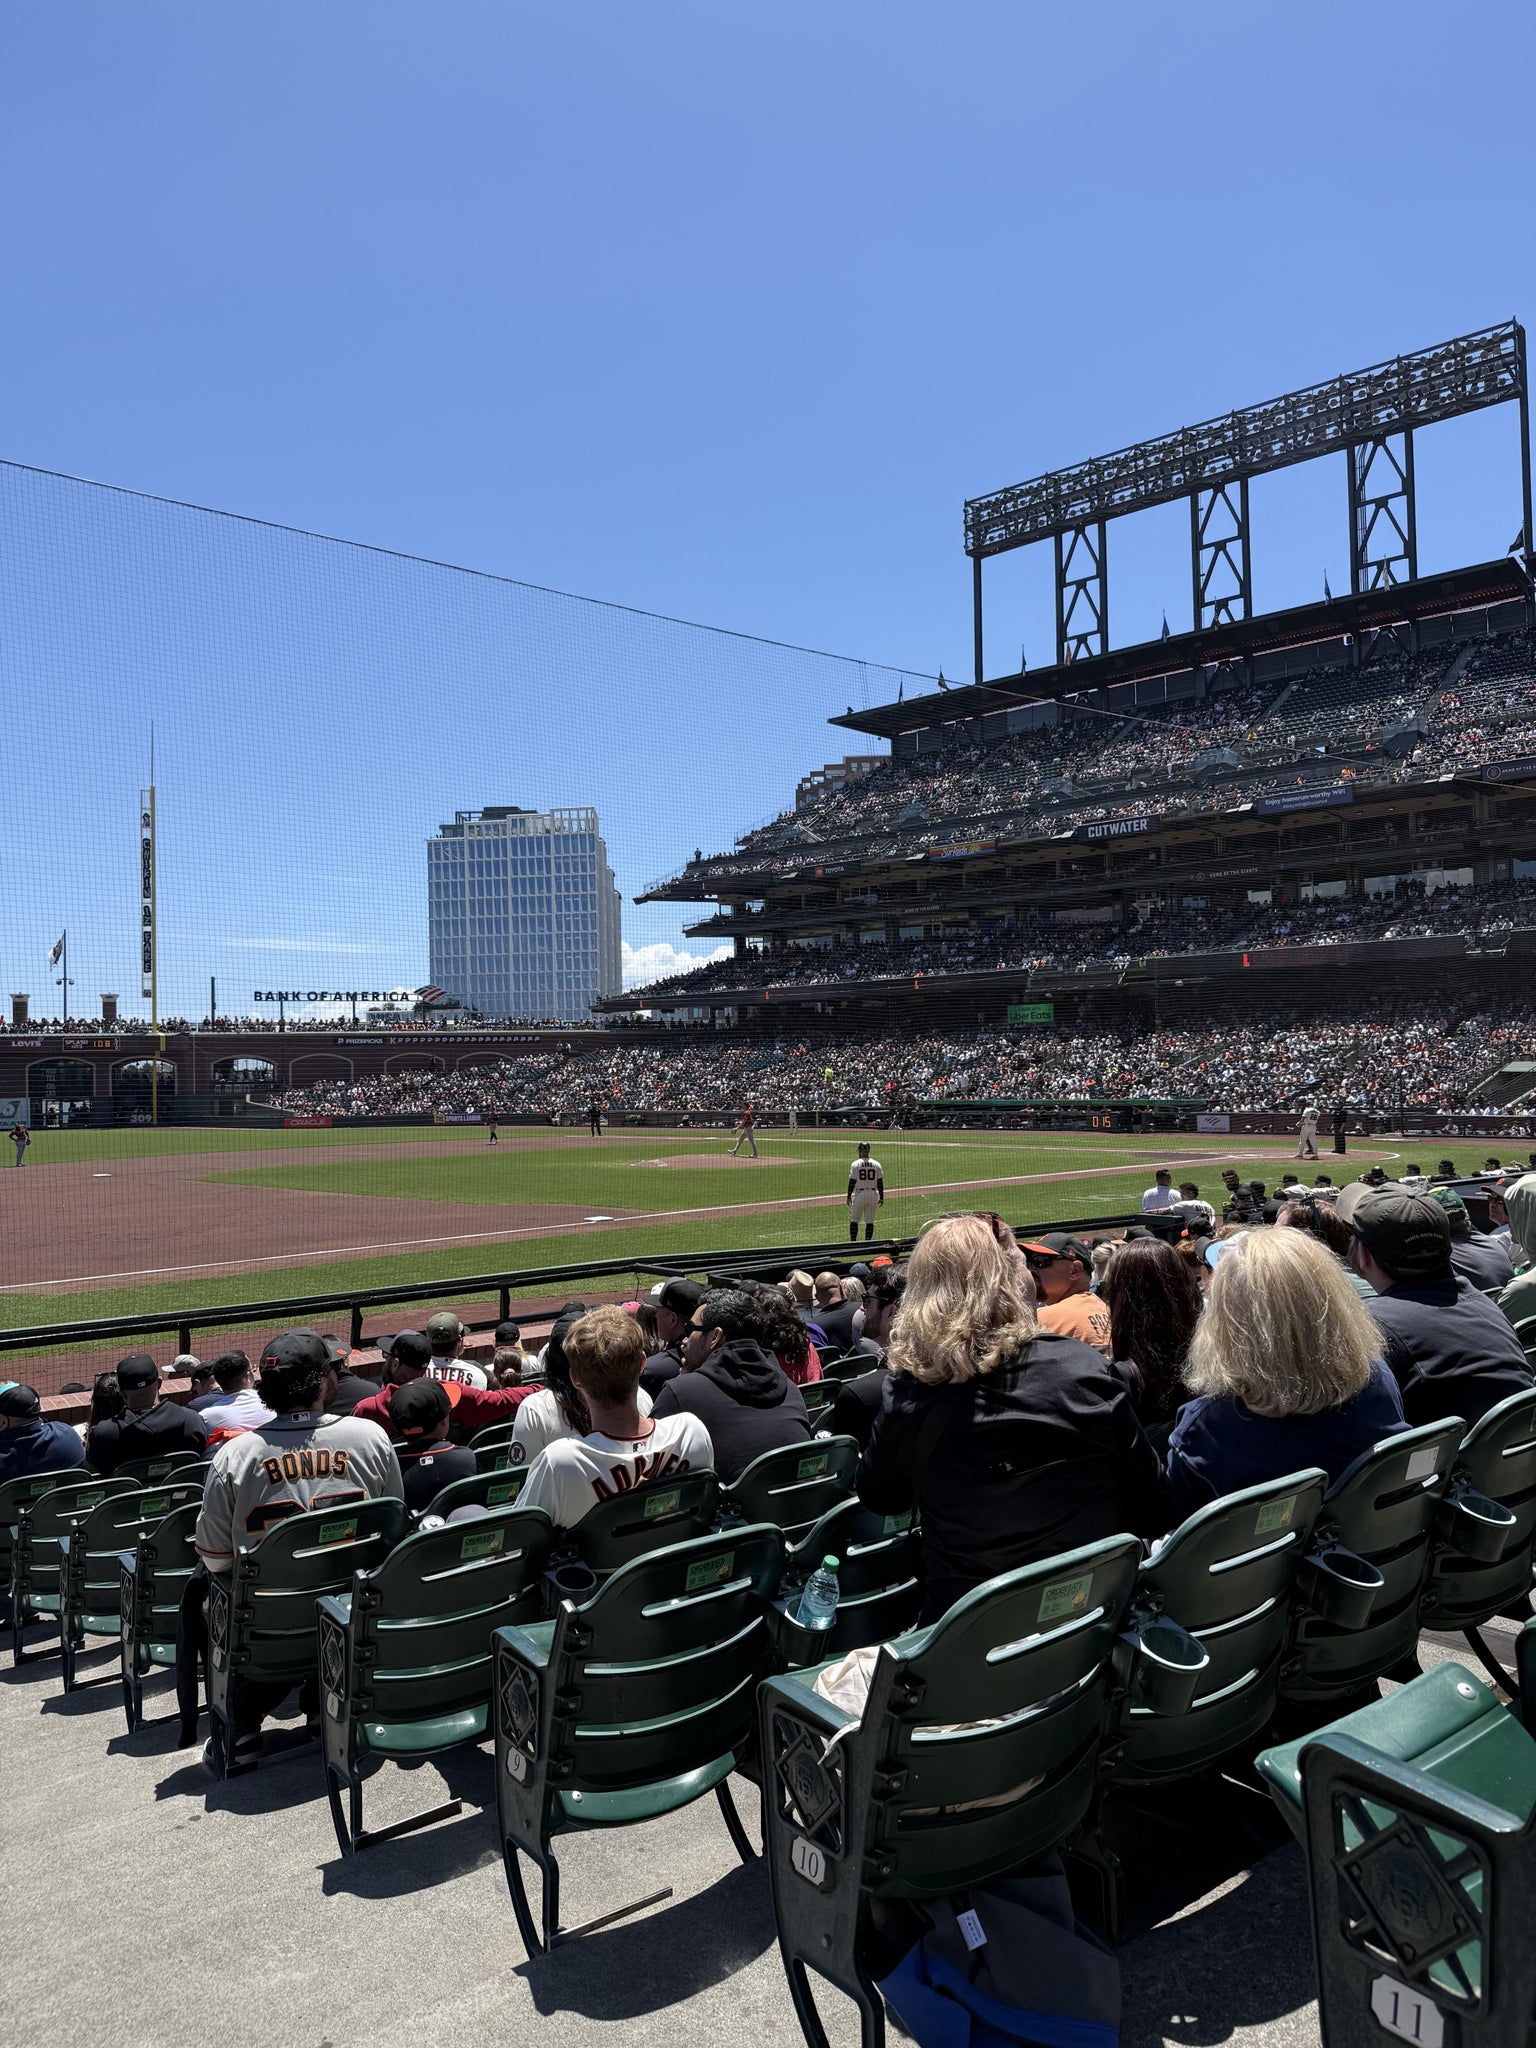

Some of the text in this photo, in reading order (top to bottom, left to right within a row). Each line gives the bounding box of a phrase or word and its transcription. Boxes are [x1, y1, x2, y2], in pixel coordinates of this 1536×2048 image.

[1265, 798, 1281, 806] Enjoy
[1332, 788, 1346, 796] WiFi
[1087, 818, 1148, 838] CUTWATER
[254, 991, 410, 1002] BANK OF AMERICA
[1010, 1011, 1051, 1020] Uber Eats
[130, 1114, 152, 1123] 309
[859, 1168, 876, 1180] 80
[1404, 1234, 1420, 1243] SANTA
[263, 1448, 348, 1486] BONDS
[514, 1753, 520, 1772] 9
[800, 1846, 819, 1878] 10
[1388, 1991, 1424, 2042] 11
